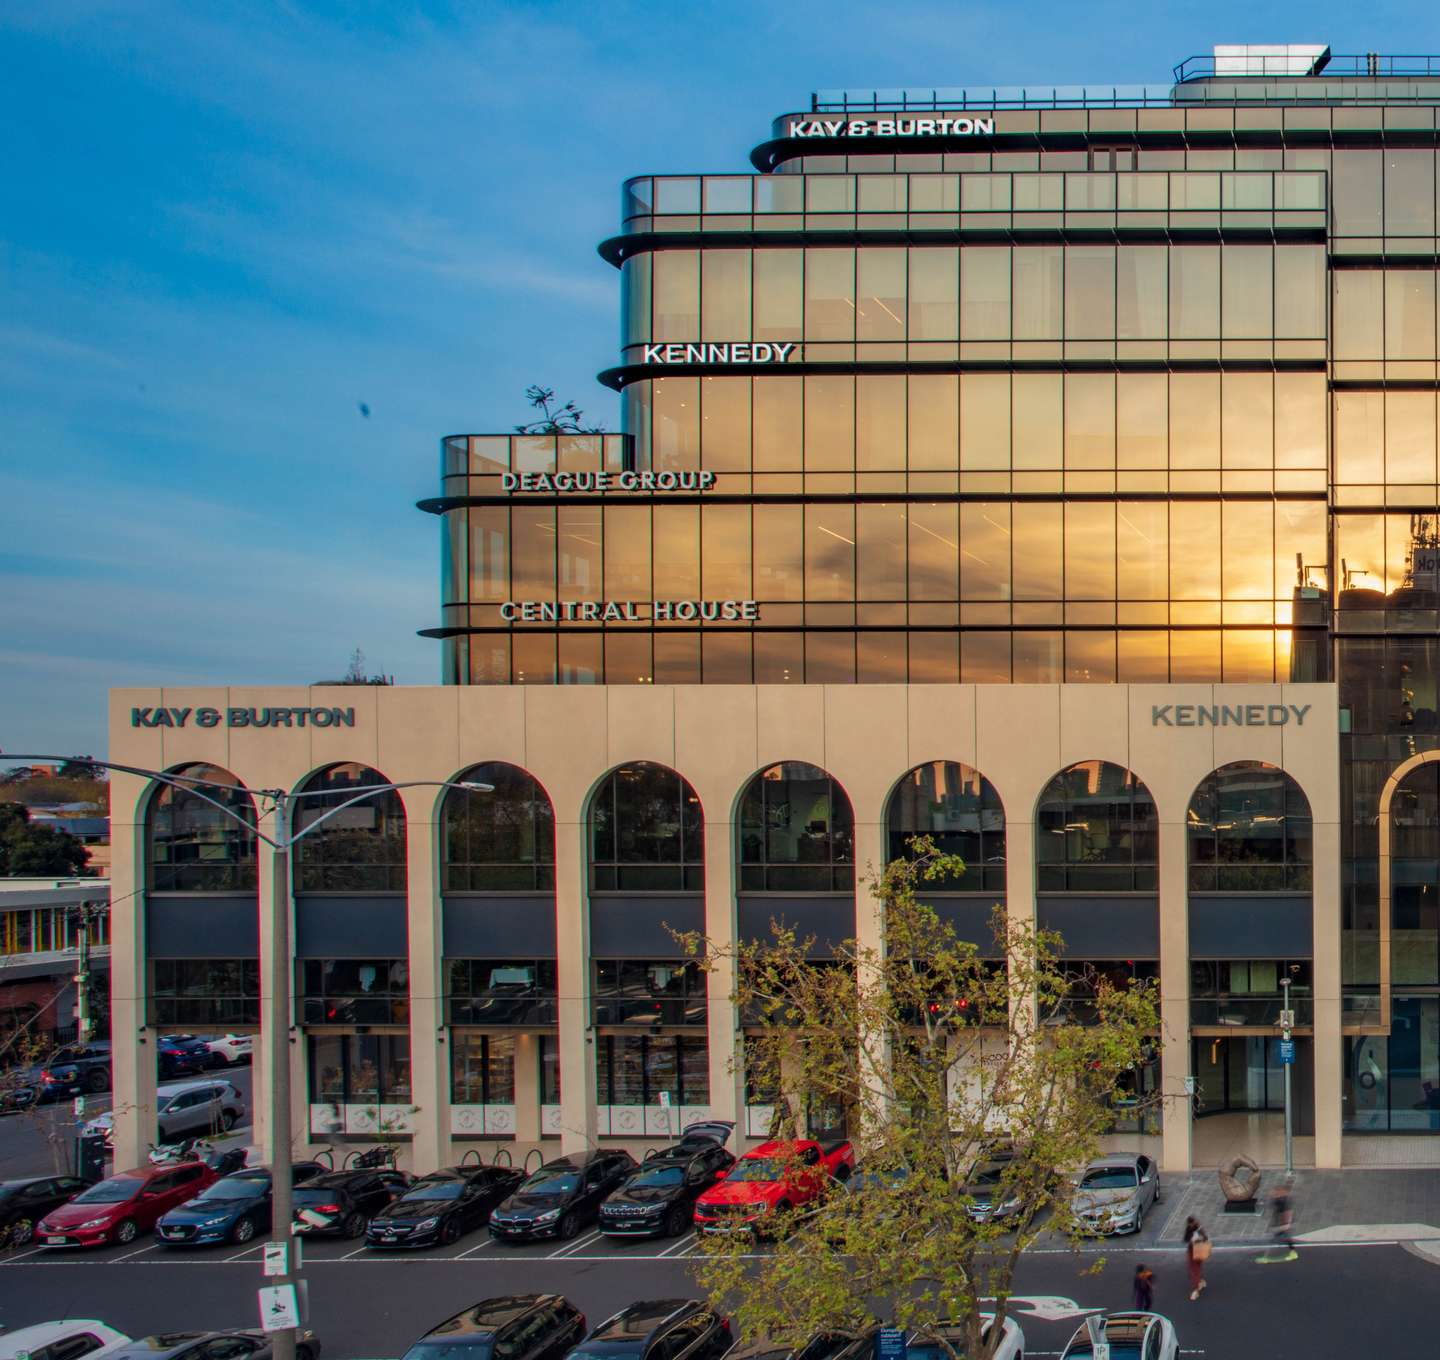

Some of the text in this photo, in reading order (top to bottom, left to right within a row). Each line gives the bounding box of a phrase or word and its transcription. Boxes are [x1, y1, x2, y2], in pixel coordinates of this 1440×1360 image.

[790, 118, 994, 138] KAY & BURTON
[643, 342, 793, 365] KENNEDY
[501, 470, 716, 491] DEAGUE GROUP
[499, 600, 758, 622] CENTRAL HOUSE
[131, 707, 356, 728] KAY & BURTON
[1151, 704, 1312, 727] KENNEDY
